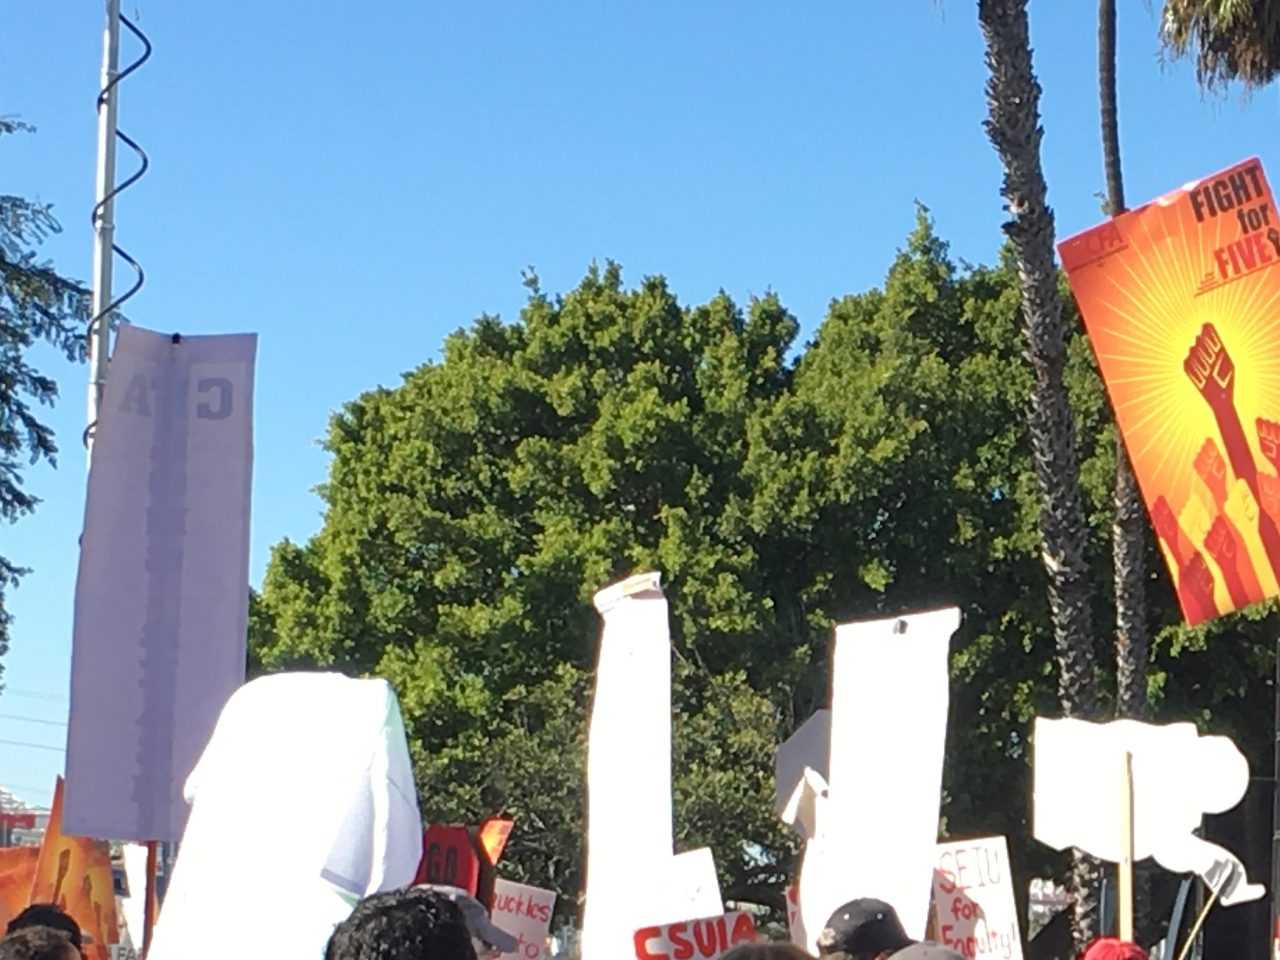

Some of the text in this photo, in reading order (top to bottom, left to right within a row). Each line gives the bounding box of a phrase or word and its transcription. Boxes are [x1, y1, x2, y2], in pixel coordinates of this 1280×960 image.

[1189, 164, 1264, 223] FIGHT
[1237, 202, 1270, 235] for
[951, 898, 980, 921] for
